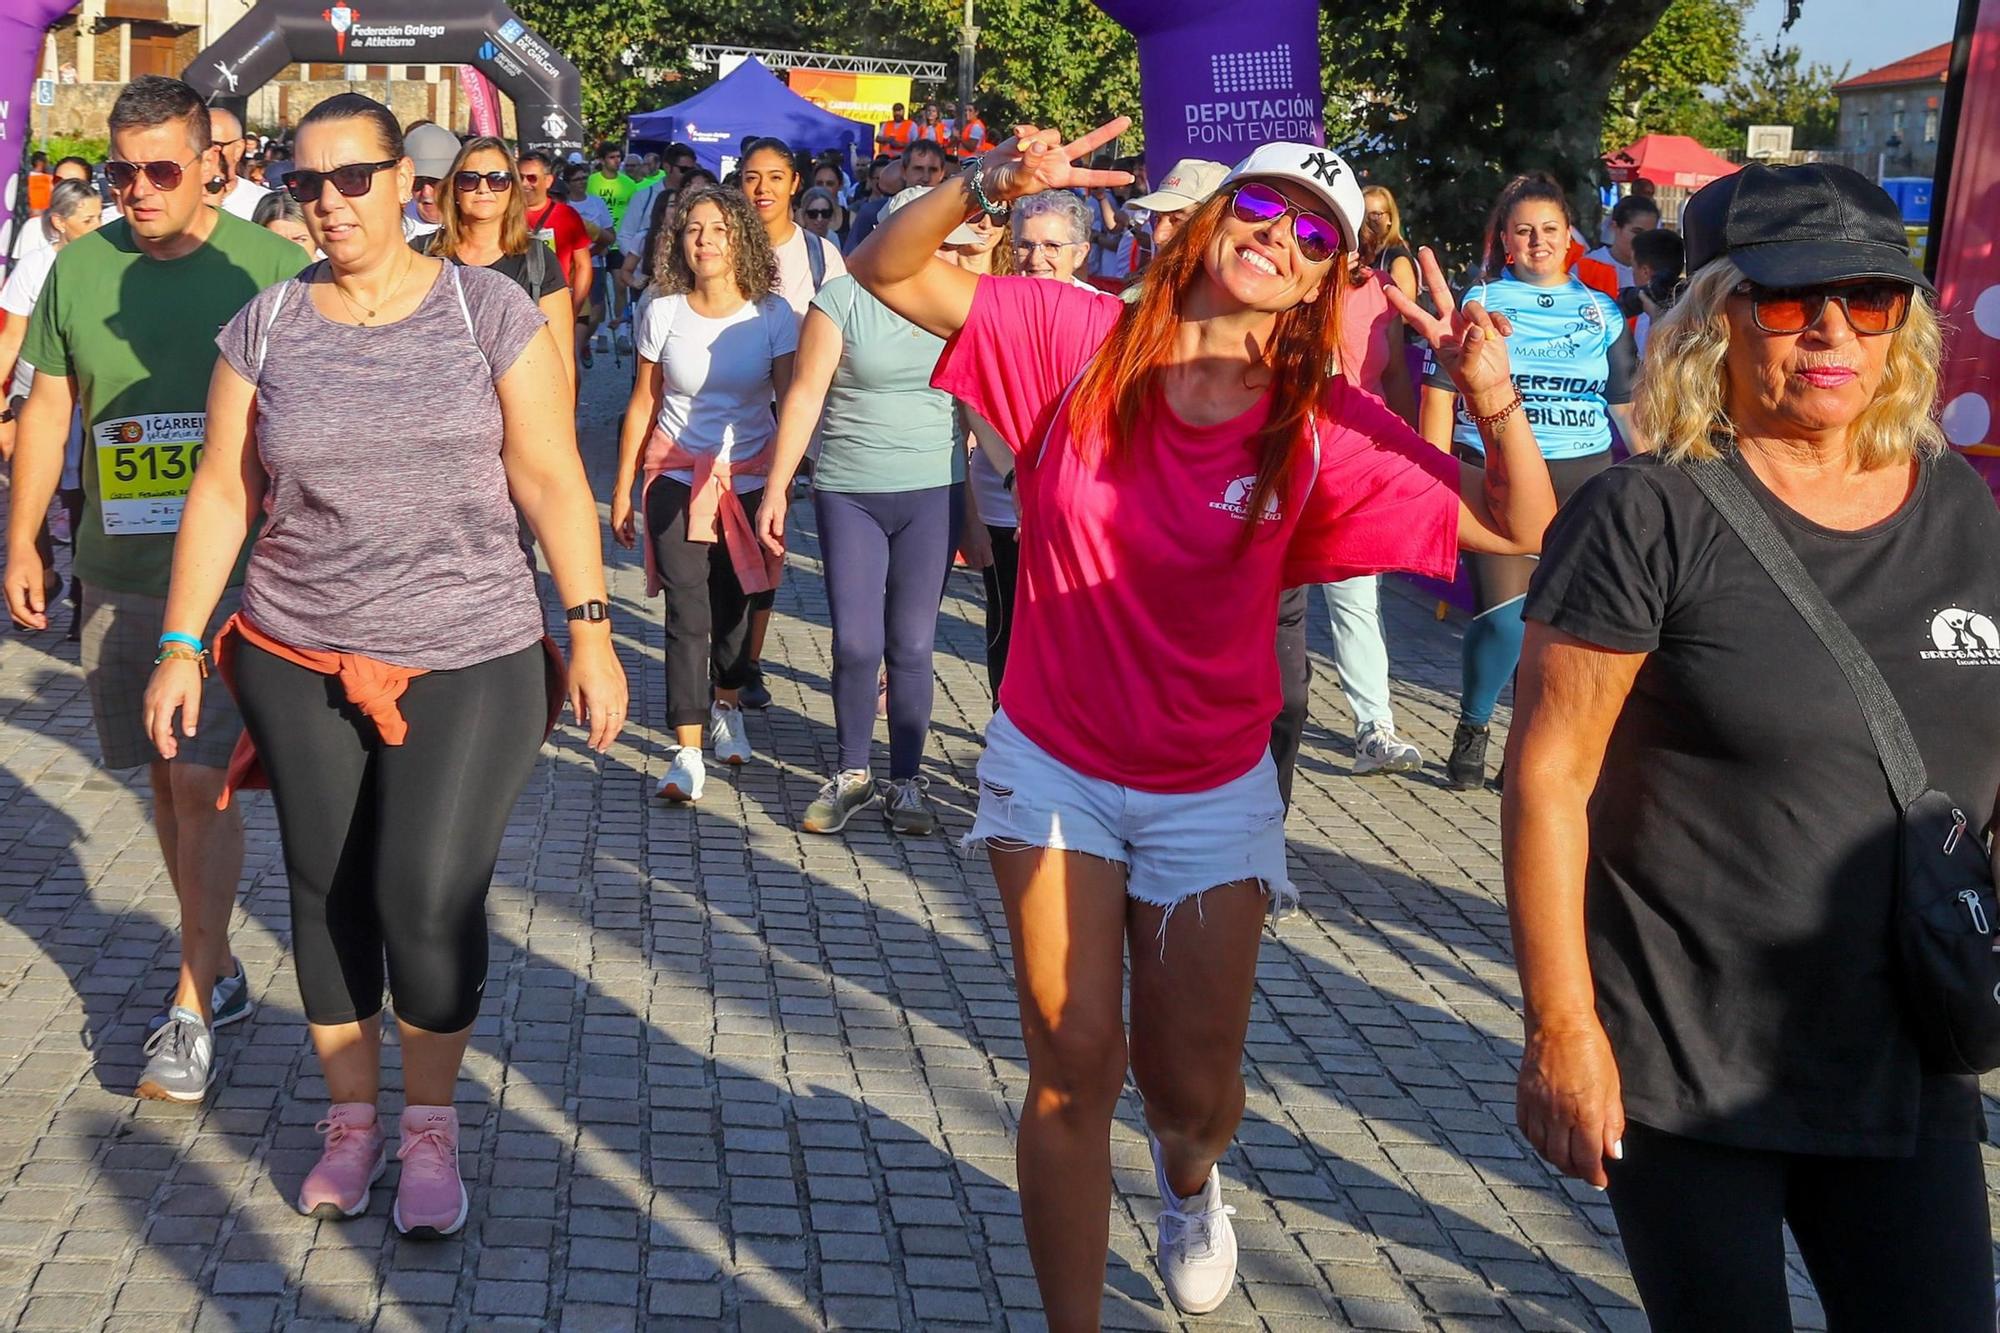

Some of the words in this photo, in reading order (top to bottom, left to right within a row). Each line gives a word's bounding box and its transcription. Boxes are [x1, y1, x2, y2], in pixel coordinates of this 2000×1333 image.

[351, 24, 403, 36] Federación
[404, 24, 445, 38] Galega
[351, 39, 363, 47] de
[364, 37, 416, 47] Atletismo
[515, 38, 528, 51] DE
[527, 47, 561, 78] GALICIA
[522, 33, 551, 59] XUNTA
[1185, 93, 1314, 124] DEPUTACIÓN
[1187, 120, 1317, 144] PONTEVEDRA
[1514, 346, 1575, 359] MARCOS
